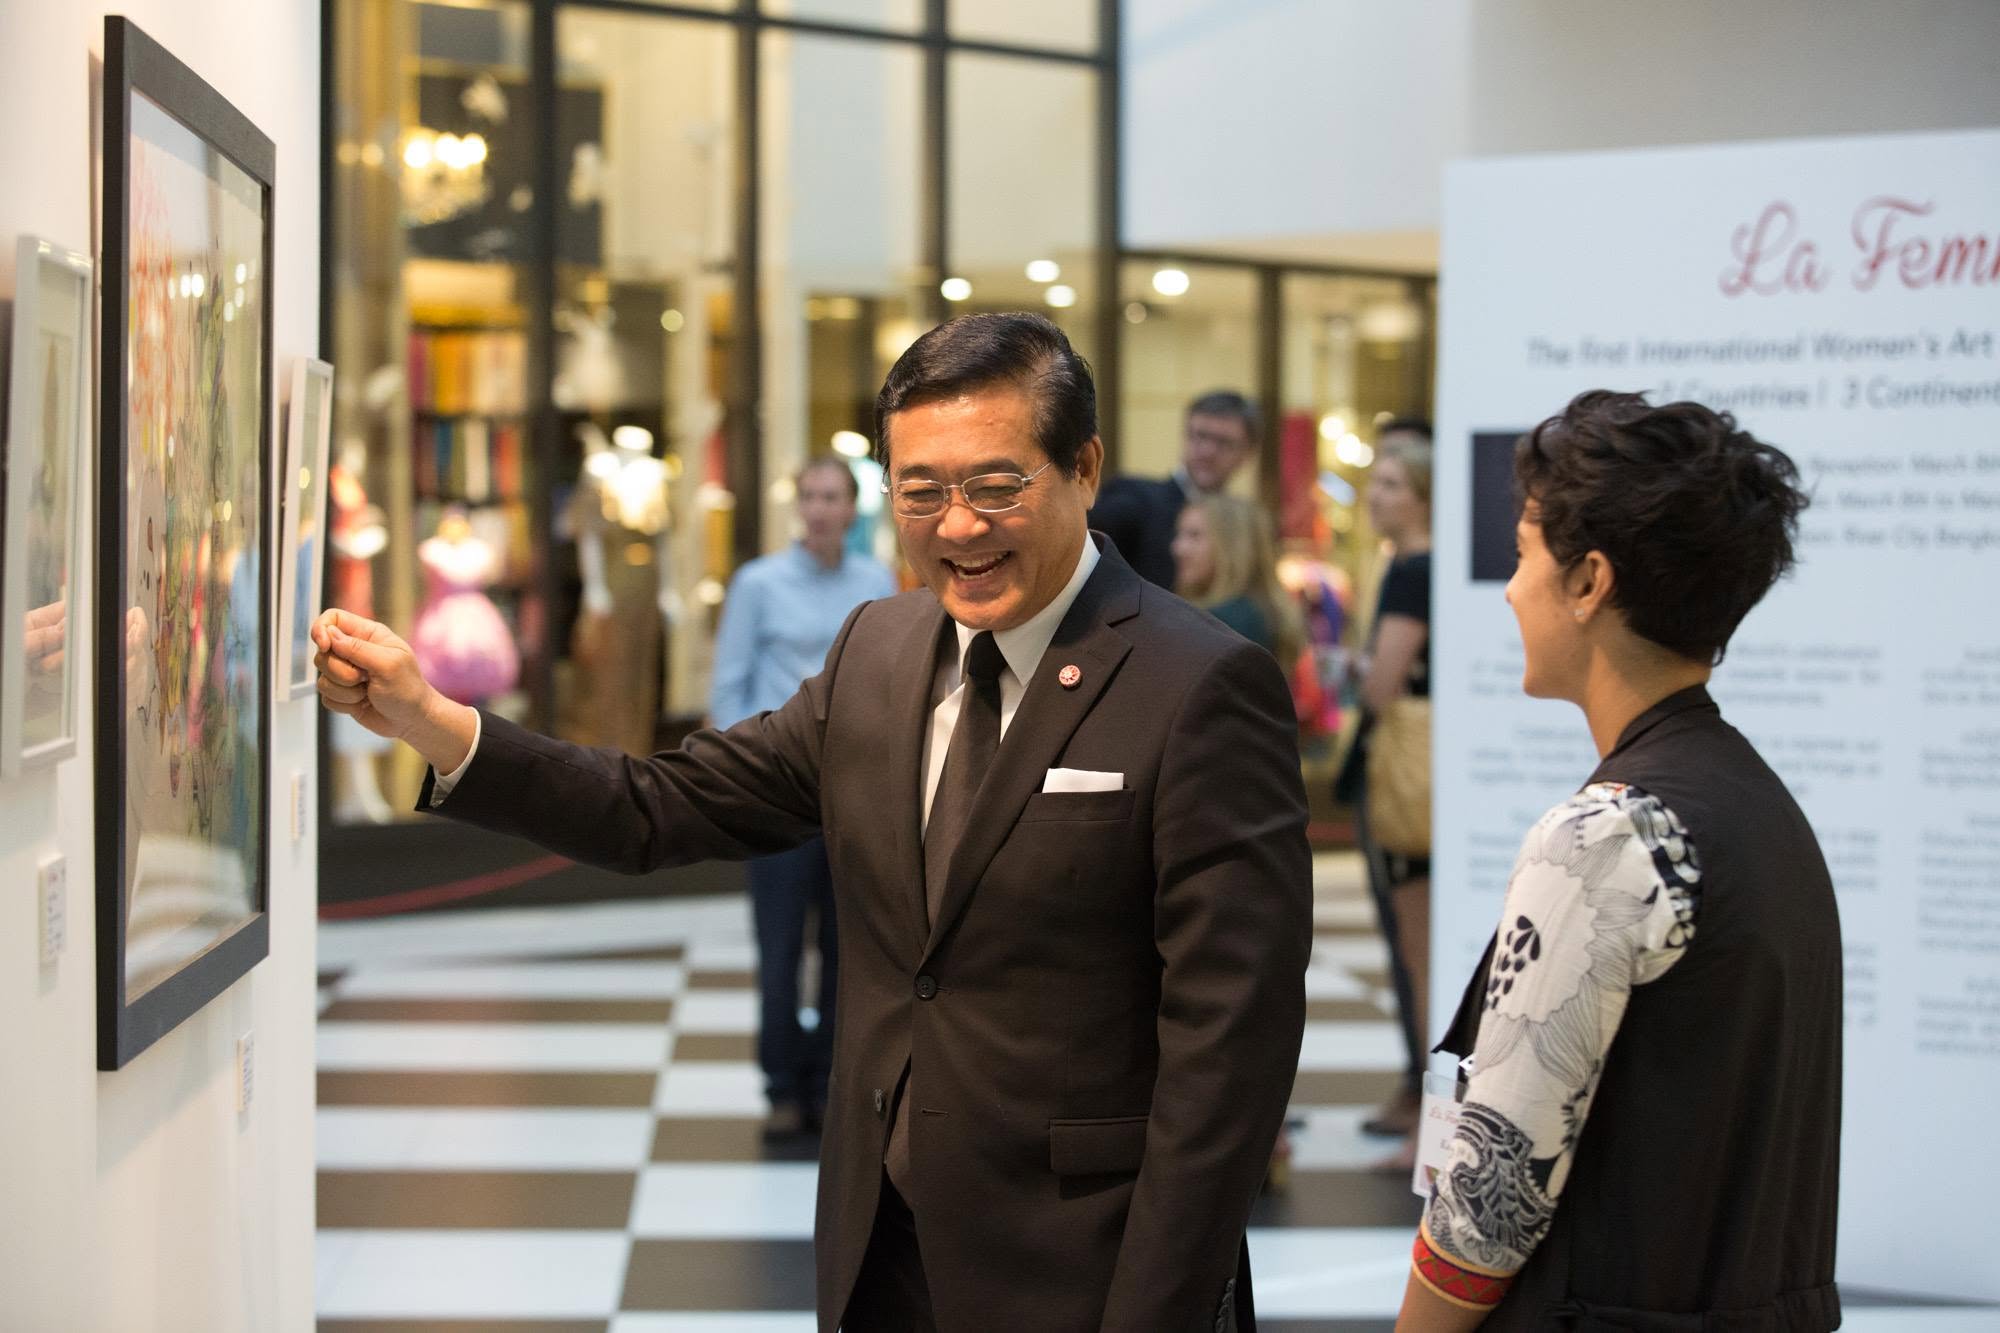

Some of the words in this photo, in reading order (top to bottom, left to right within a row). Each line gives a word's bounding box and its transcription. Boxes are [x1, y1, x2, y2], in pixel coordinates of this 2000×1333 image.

[1718, 199, 1831, 296] La
[1528, 338, 1570, 366] The
[1636, 336, 1805, 363] International
[1813, 331, 1941, 360] Women's
[1949, 327, 1994, 358] Art
